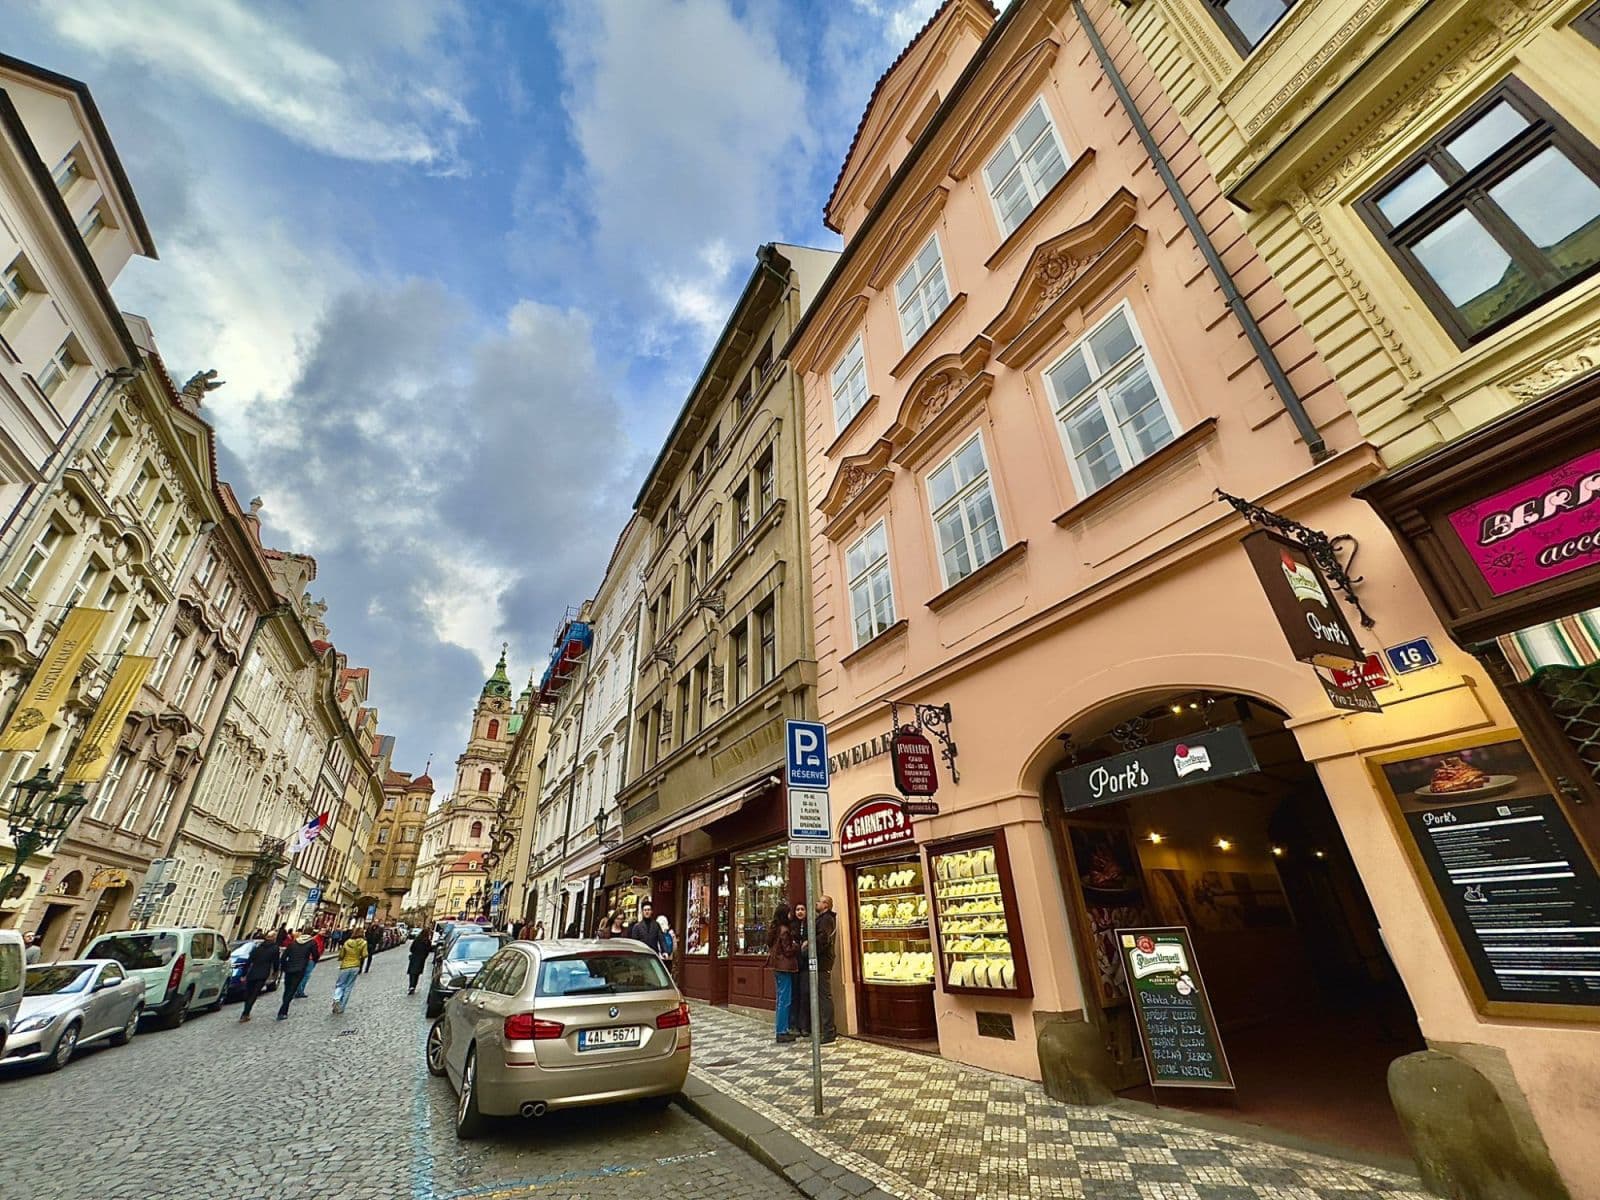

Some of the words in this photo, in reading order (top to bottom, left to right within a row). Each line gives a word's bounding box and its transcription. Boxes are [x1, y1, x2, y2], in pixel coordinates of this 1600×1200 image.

[1305, 611, 1350, 645] Pork's
[1399, 647, 1422, 666] 16
[34, 639, 78, 702] RESTAURACE
[794, 728, 818, 765] P
[897, 743, 930, 755] JEWELLERY
[791, 769, 825, 780] RÉSERVÉ
[1089, 760, 1149, 798] Pork's
[853, 808, 894, 837] GARNETS
[1422, 811, 1457, 826] Pork's
[1136, 953, 1158, 970] Pilsner
[1155, 952, 1180, 965] Urquell
[588, 1031, 606, 1044] 4AL
[612, 1028, 636, 1041] 5671
